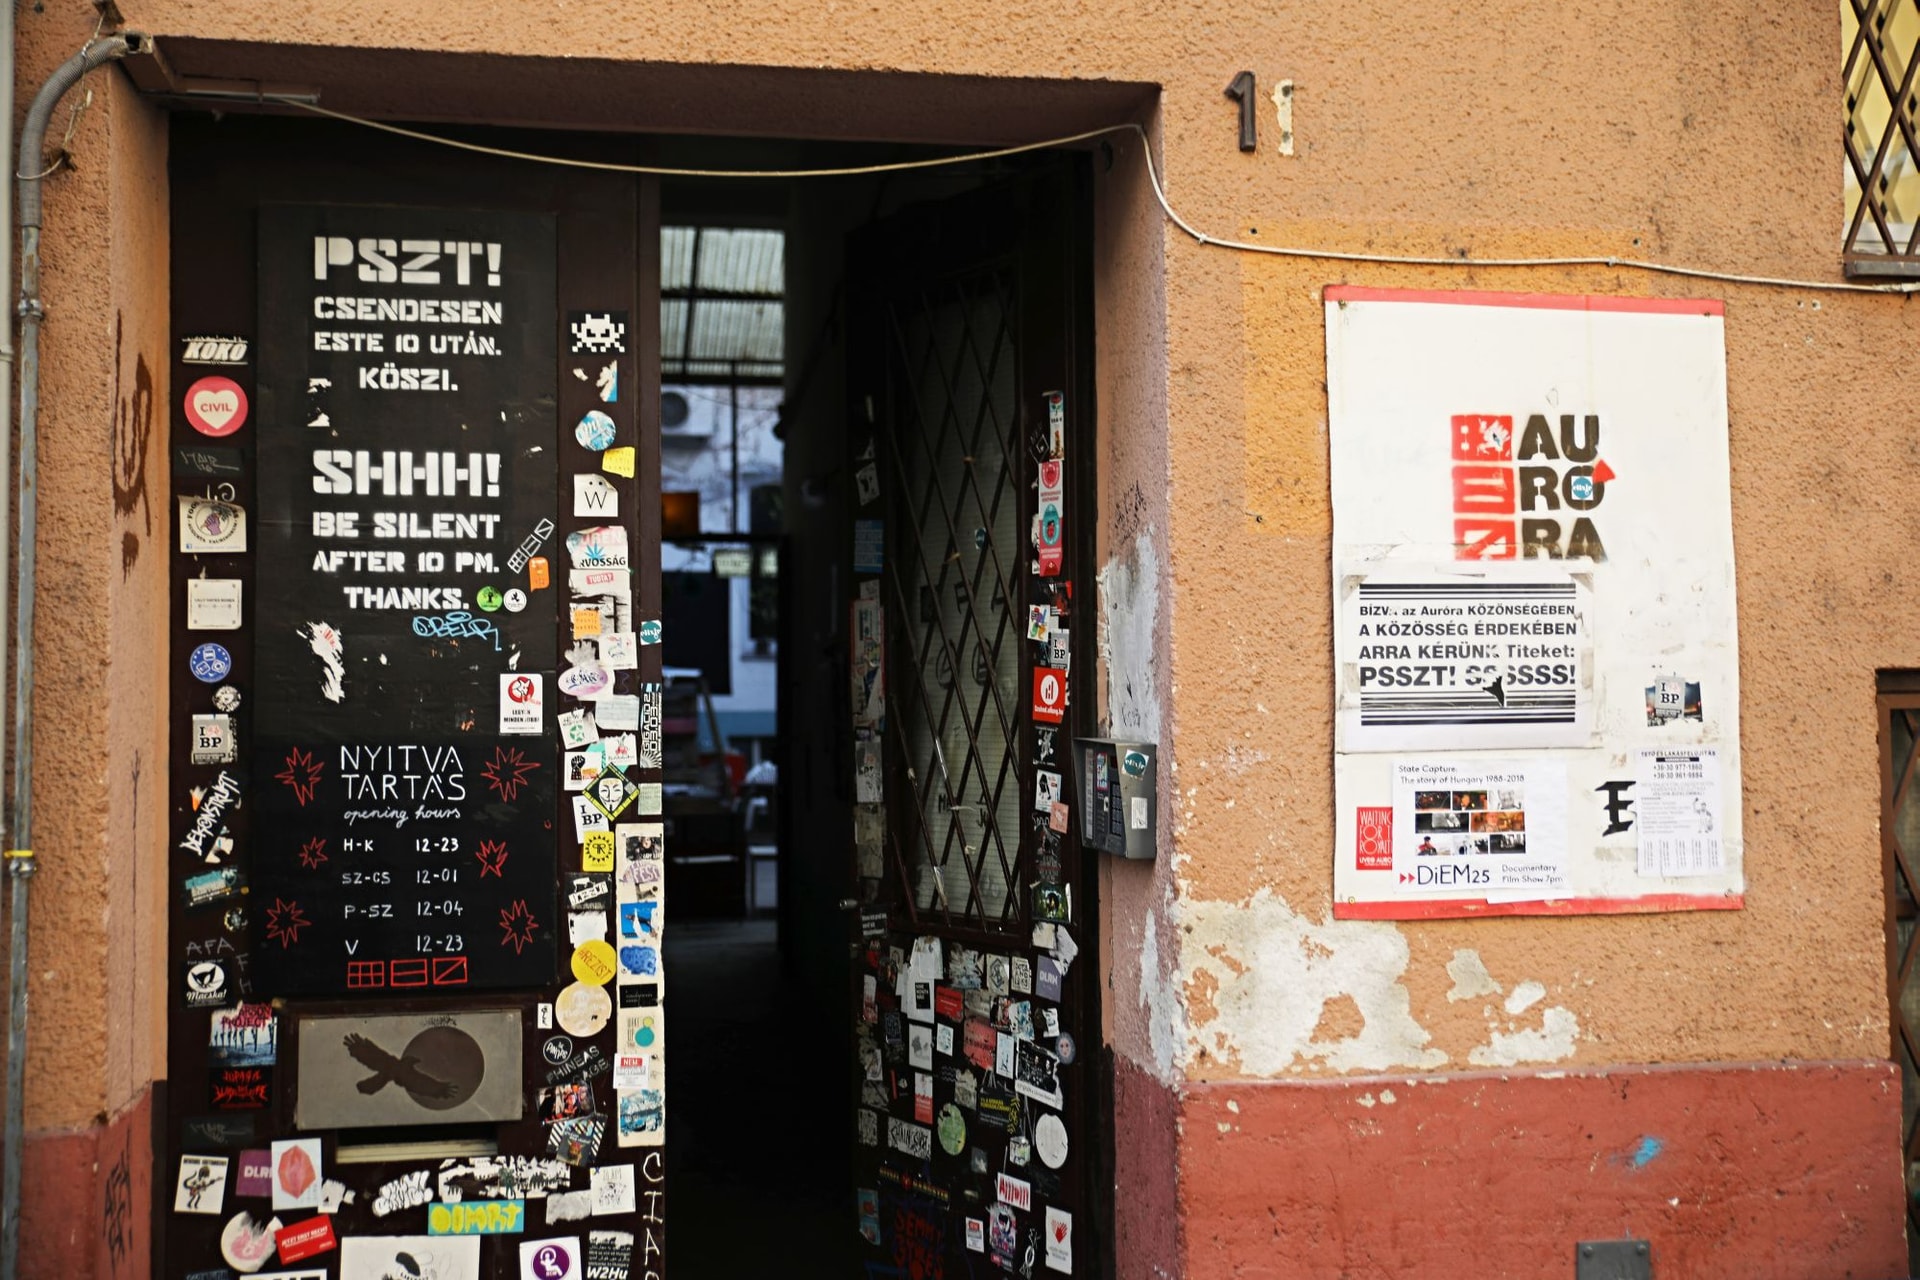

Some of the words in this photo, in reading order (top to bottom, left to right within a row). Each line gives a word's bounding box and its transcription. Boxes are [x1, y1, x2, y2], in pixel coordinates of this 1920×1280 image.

[314, 236, 502, 286] PSZT!
[314, 296, 502, 324] CSENDESEN
[183, 341, 249, 361] KOKO
[314, 332, 384, 352] ESTE
[395, 333, 420, 354] 10
[430, 330, 502, 356] UTÁN.
[359, 362, 458, 391] KÖSZI.
[200, 402, 232, 413] CIVIL
[312, 449, 501, 497] SHHH!
[312, 511, 360, 538] BE
[373, 512, 500, 540] SILENT
[312, 550, 405, 572] AFTER
[417, 551, 444, 573] 10
[456, 552, 500, 574] PM.
[343, 586, 469, 610] THANKS.
[1402, 607, 1416, 616] az
[1420, 605, 1463, 616] Auróra
[1467, 604, 1575, 616] KÖZÖNSÉGÉBEN
[1359, 624, 1370, 636] A
[1376, 621, 1469, 636] KÖZÖSSÉG
[1474, 620, 1577, 636] ÉRDEKÉBEN
[1054, 649, 1066, 659] BP
[1359, 645, 1412, 659] ARRA
[1418, 641, 1500, 659] KÉRÜNK
[1507, 644, 1575, 658] Titeket:
[1359, 665, 1456, 686] PSSZT!
[1661, 682, 1666, 692] I
[1661, 693, 1680, 704] BP
[200, 726, 205, 737] I
[200, 737, 222, 748] BP
[340, 745, 464, 773] NYITVA
[1399, 765, 1420, 773] State
[340, 774, 467, 801] TARTÁS
[1401, 776, 1415, 784] The
[1417, 776, 1437, 785] story
[1439, 776, 1448, 784] of
[1451, 776, 1483, 786] Hungary
[344, 806, 409, 828] opening
[415, 804, 461, 820] hours
[582, 814, 603, 826] BP
[343, 838, 374, 852] H-K
[415, 838, 460, 852] 12-23
[342, 871, 392, 885] SZ-CS
[416, 869, 458, 884] 12-01
[1417, 863, 1491, 886] DiEM25
[1501, 864, 1557, 873] Documentary
[1502, 874, 1520, 883] Film
[1521, 875, 1543, 883] Show
[416, 901, 464, 916] 12-04
[345, 939, 359, 955] V
[416, 934, 464, 952] 12-23
[186, 988, 228, 1001] Macska!
[587, 1265, 629, 1279] W2Hu
